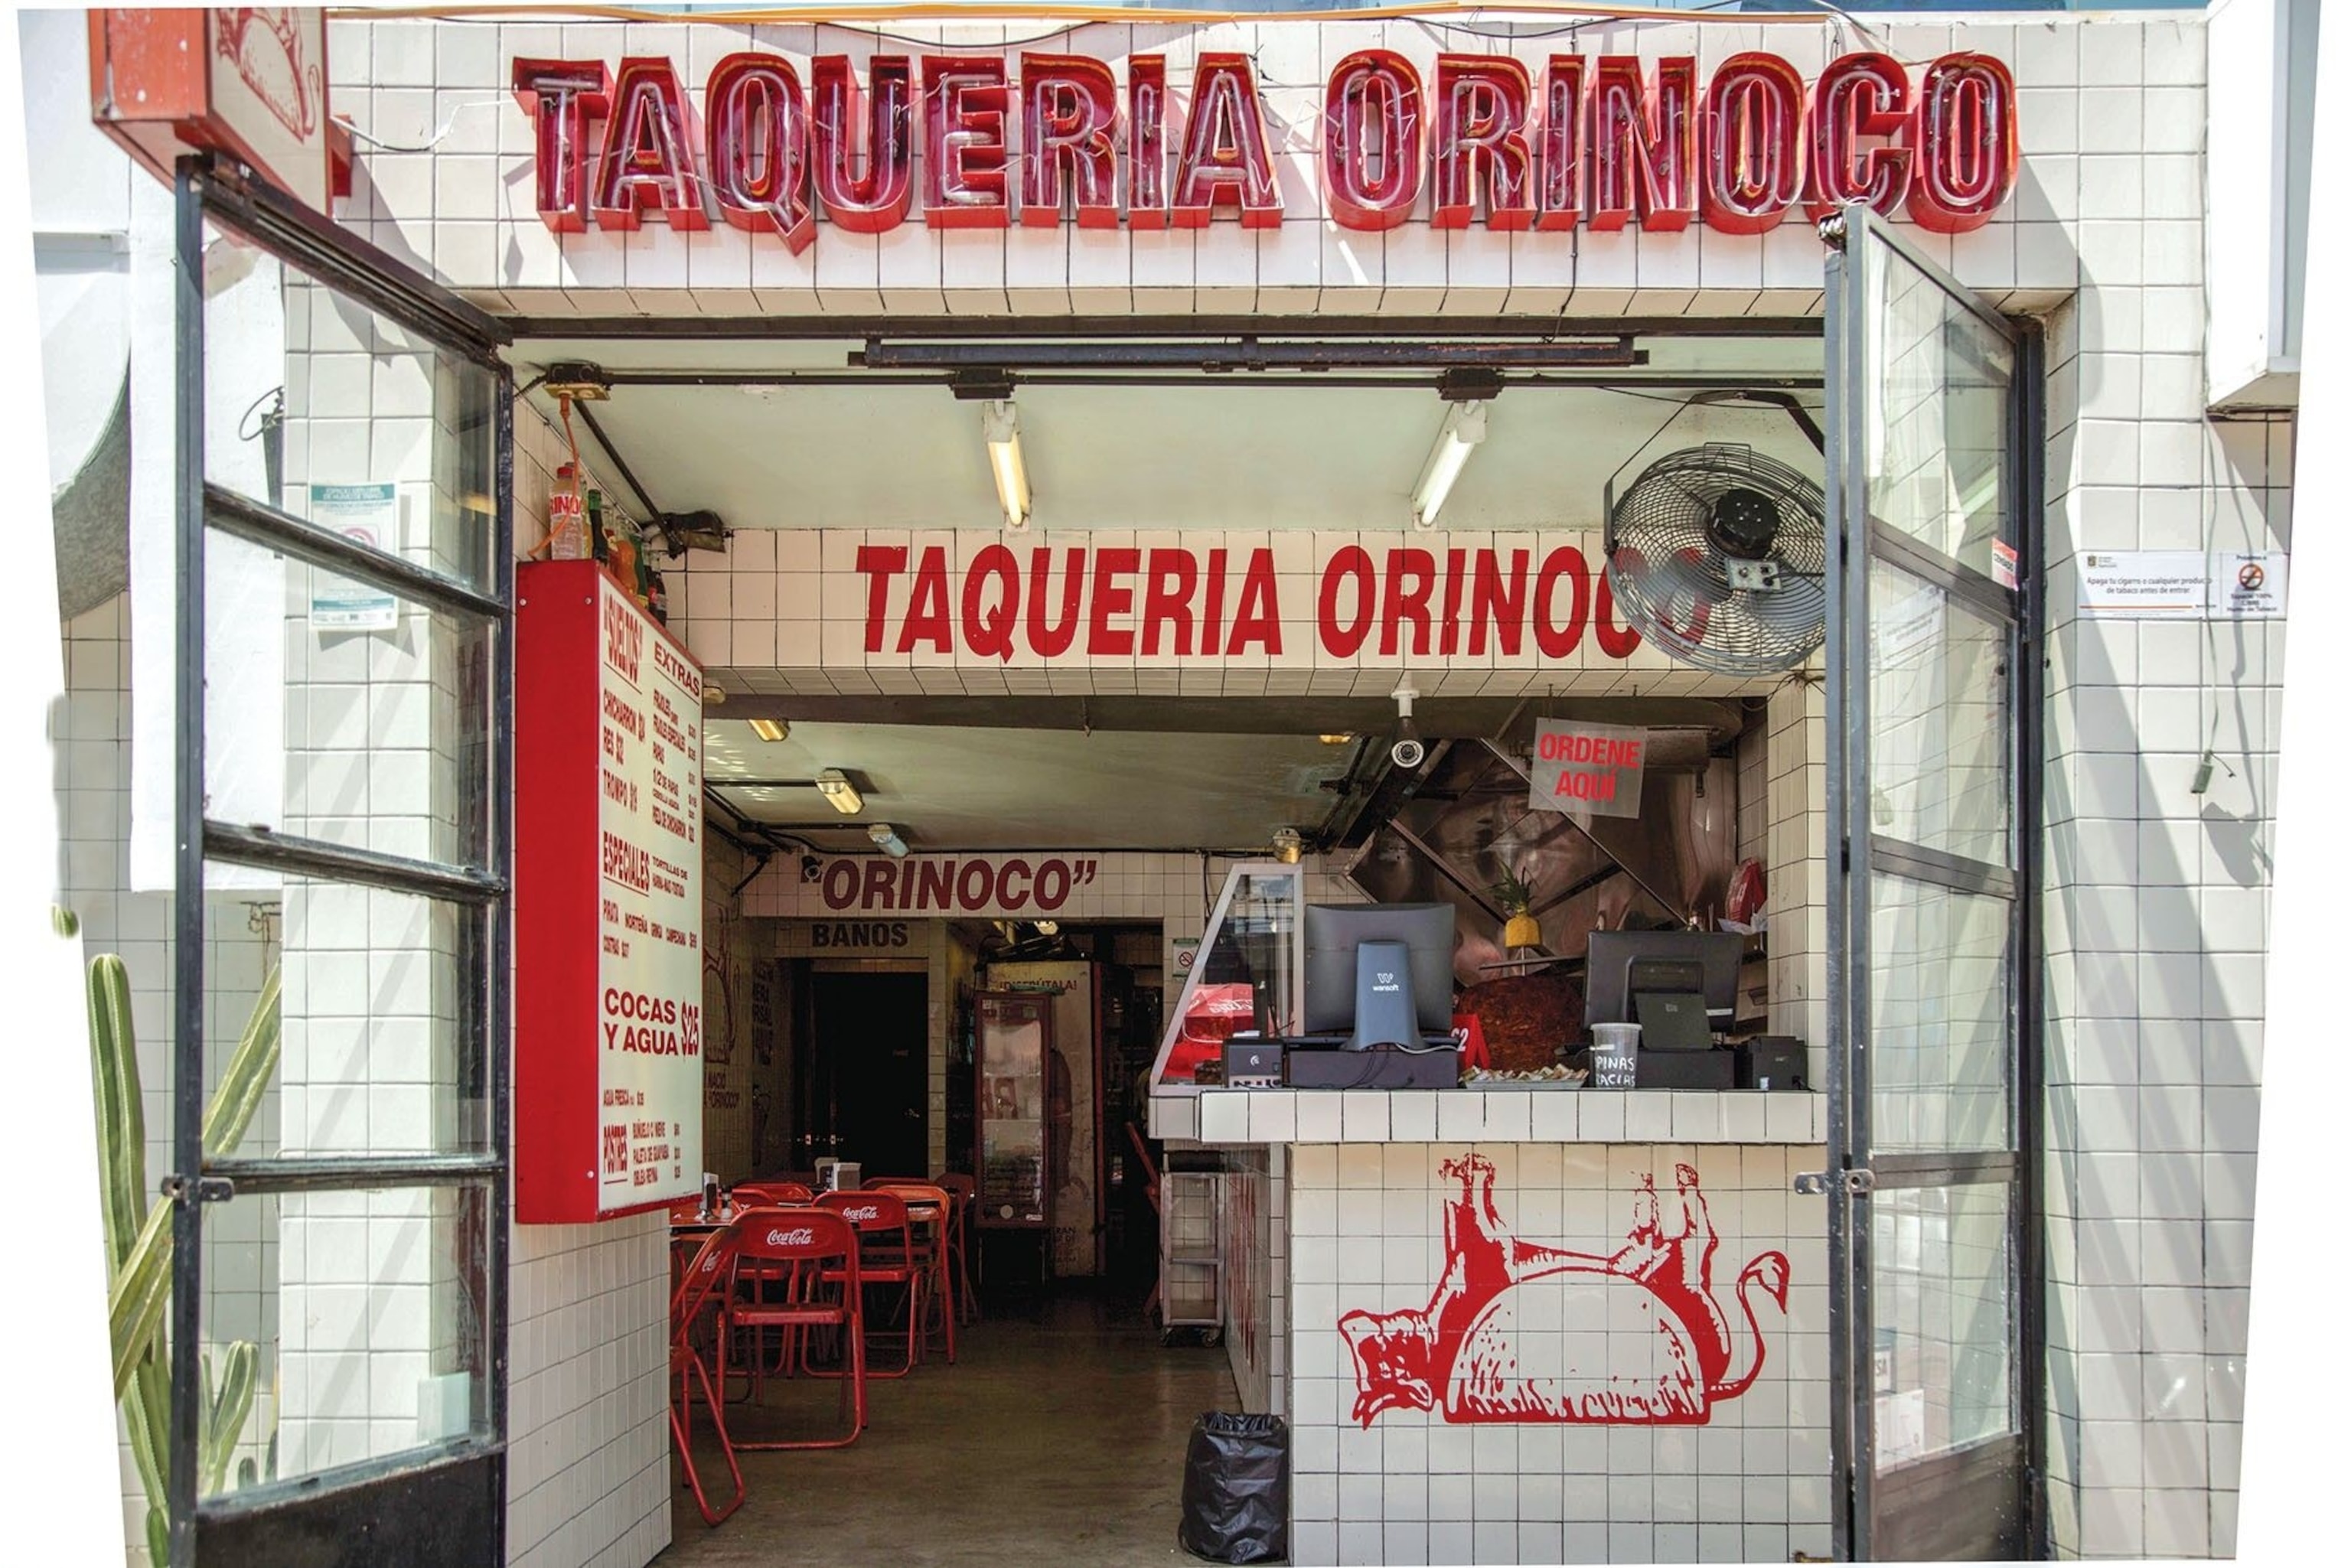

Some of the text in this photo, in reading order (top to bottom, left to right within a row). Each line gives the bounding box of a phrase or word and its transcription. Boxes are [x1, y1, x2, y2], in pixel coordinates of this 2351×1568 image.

[513, 49, 2018, 256] TAQUERIA ORINOCO
[2148, 577, 2180, 586] cualquier
[856, 545, 1283, 664] TAQUERIA
[654, 641, 699, 697] EXTRAS
[1539, 732, 1642, 768] ORDENE
[1554, 769, 1617, 802] AQUÍ
[604, 831, 649, 891] ESPECIALES
[653, 856, 680, 878] TORTILLAS
[604, 1022, 678, 1056] Y AGUA
[605, 988, 676, 1025] COCAS
[681, 999, 699, 1058] $25
[767, 1228, 814, 1245] Coca-Cola
